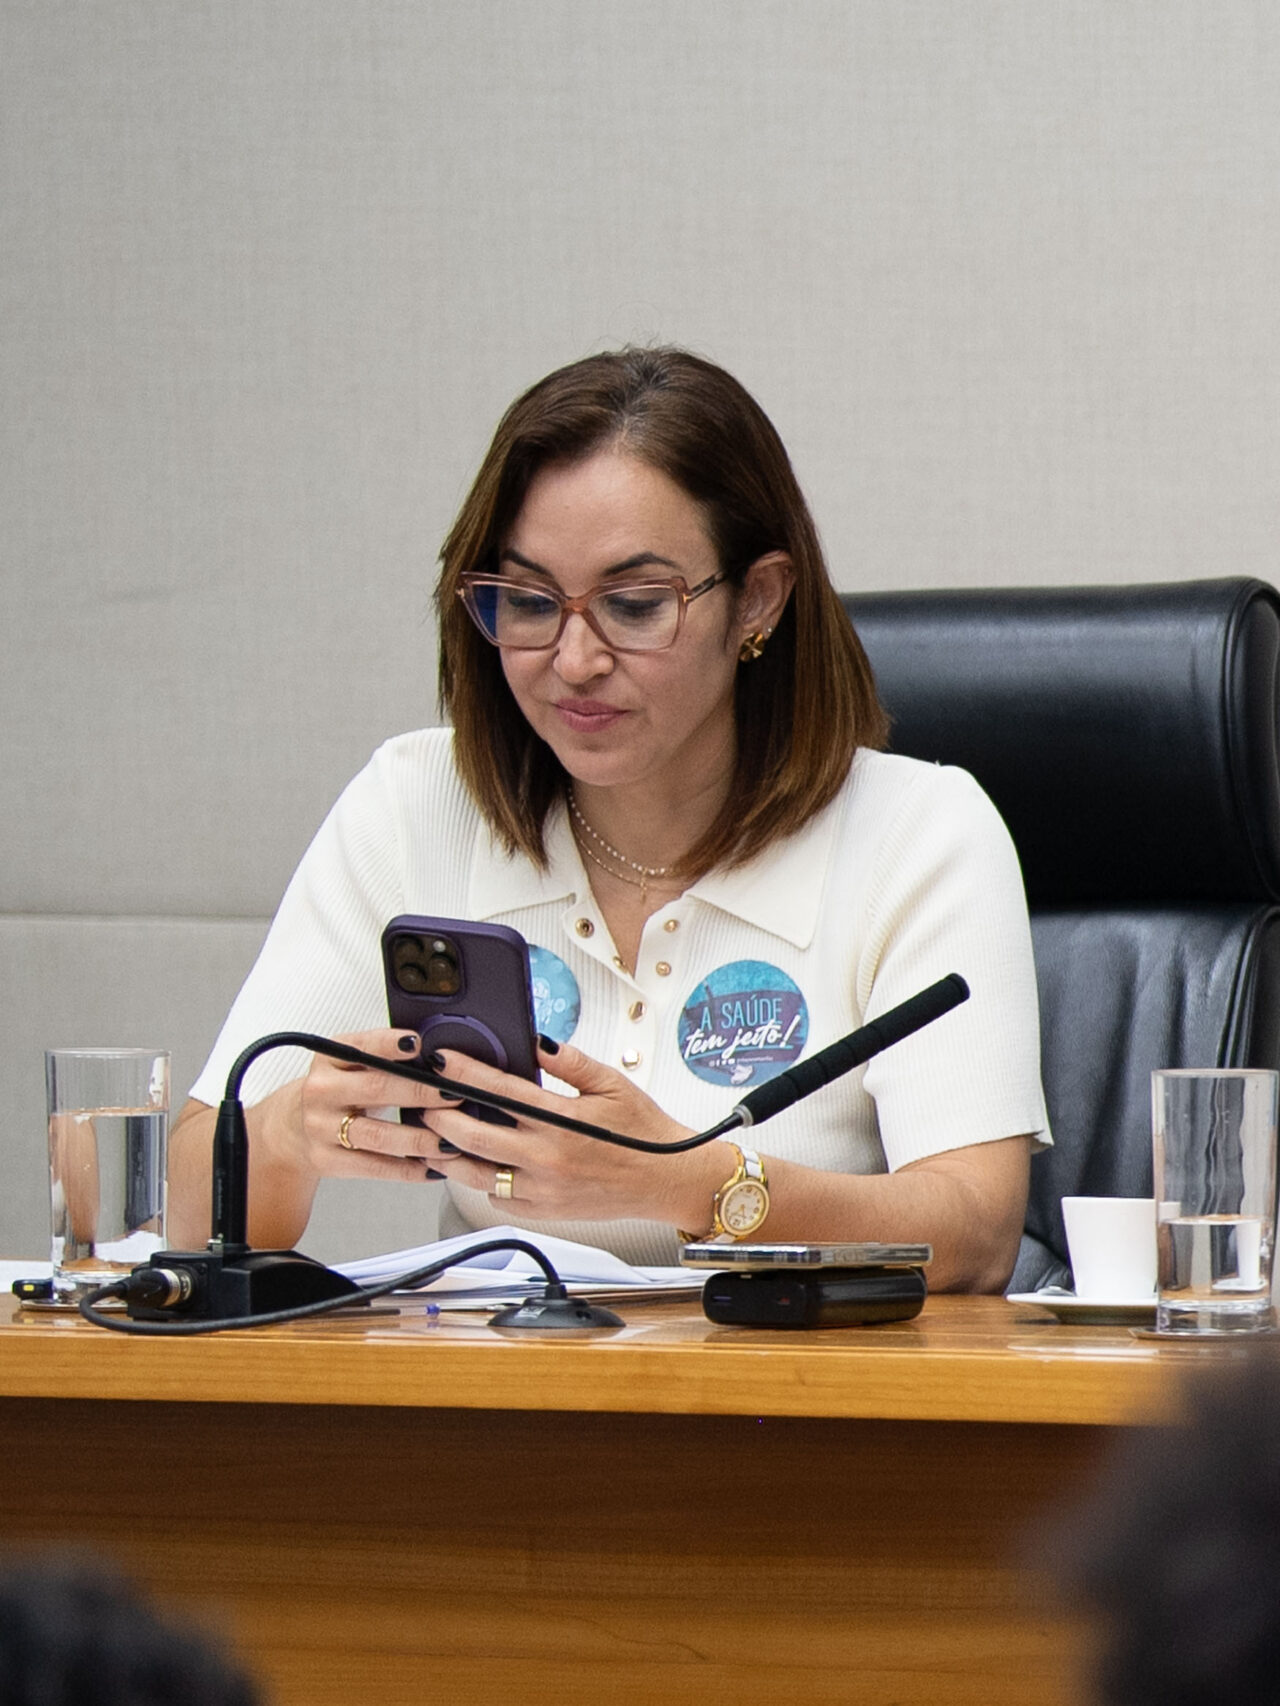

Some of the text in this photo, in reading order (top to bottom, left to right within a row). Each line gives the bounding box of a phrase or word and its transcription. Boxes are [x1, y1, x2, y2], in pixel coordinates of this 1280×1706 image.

[700, 994, 783, 1031] A SAÚDE
[684, 1015, 801, 1060] tem jeito!
